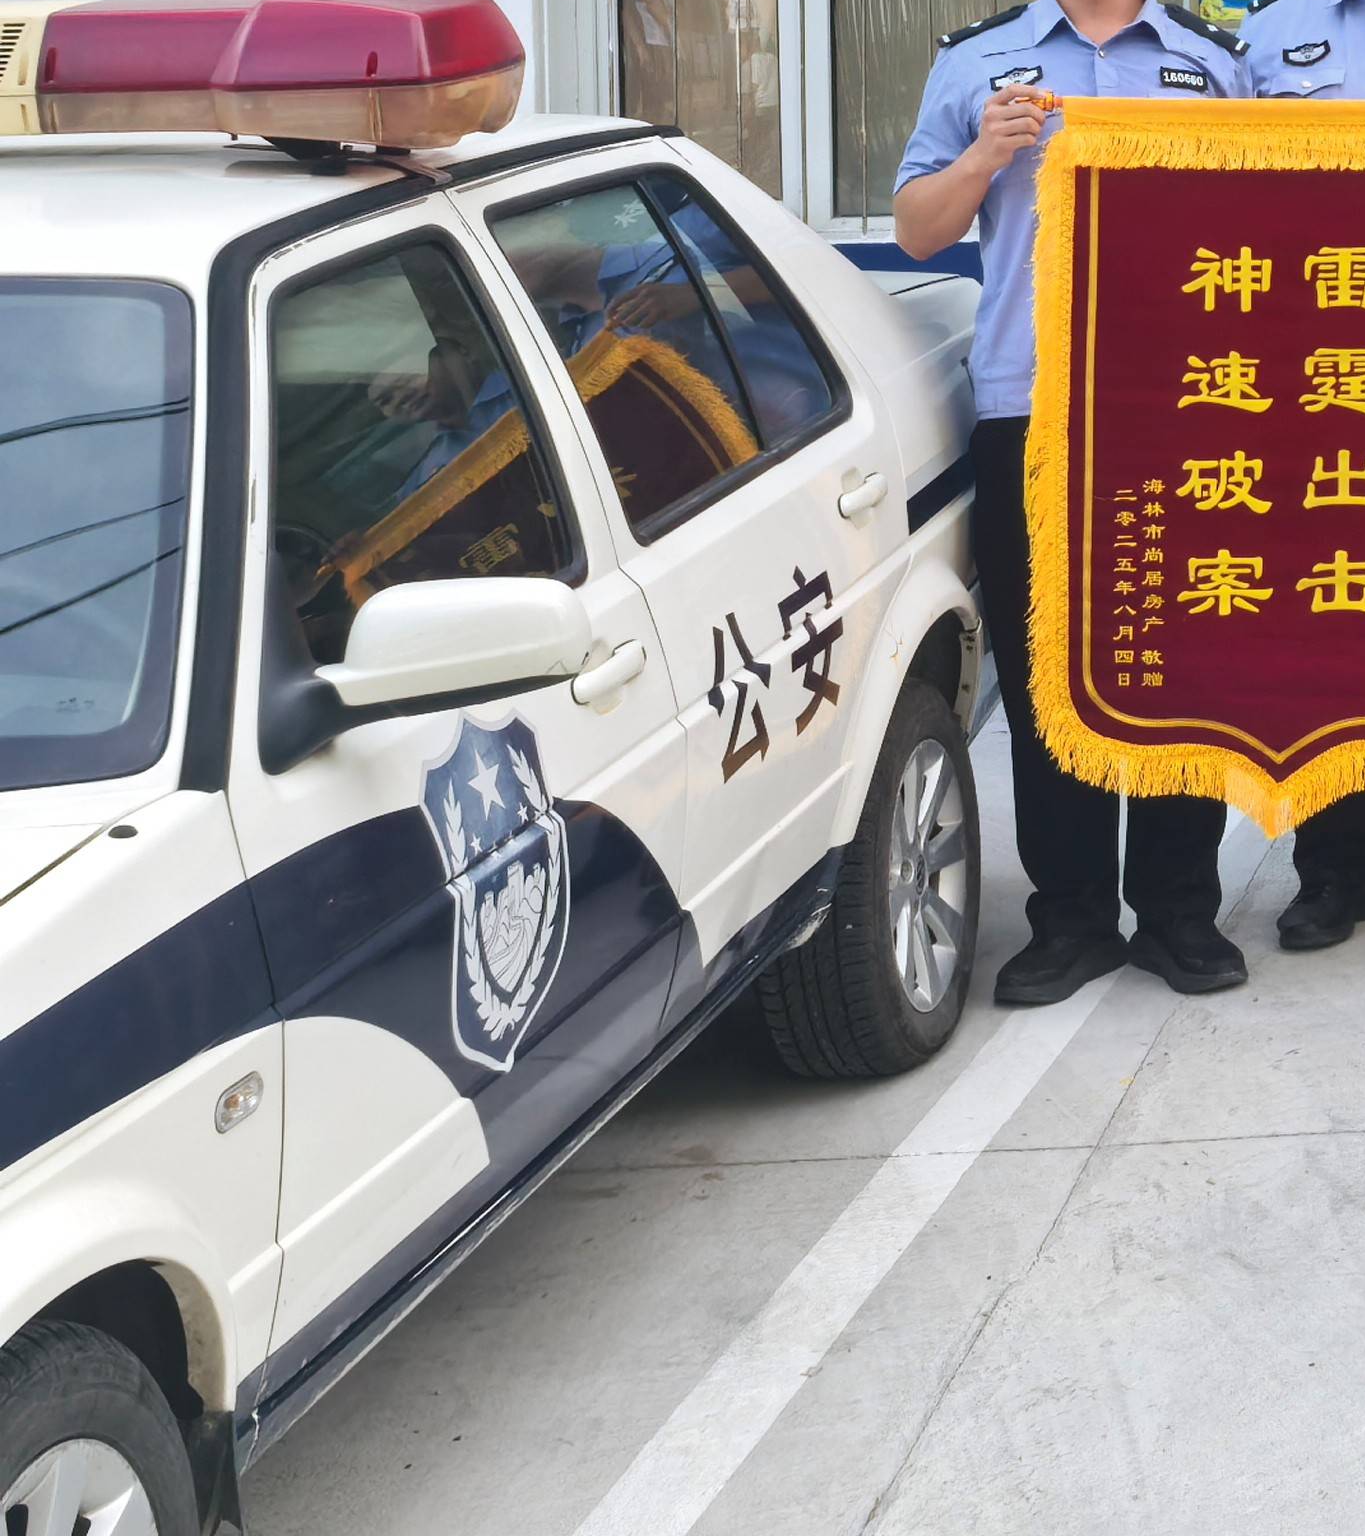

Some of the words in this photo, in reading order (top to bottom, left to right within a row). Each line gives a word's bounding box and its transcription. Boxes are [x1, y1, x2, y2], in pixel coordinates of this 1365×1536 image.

[1176, 247, 1273, 616] 神速破案
[708, 566, 842, 783] 公安
[1113, 490, 1137, 685] 二零二五年八月四日
